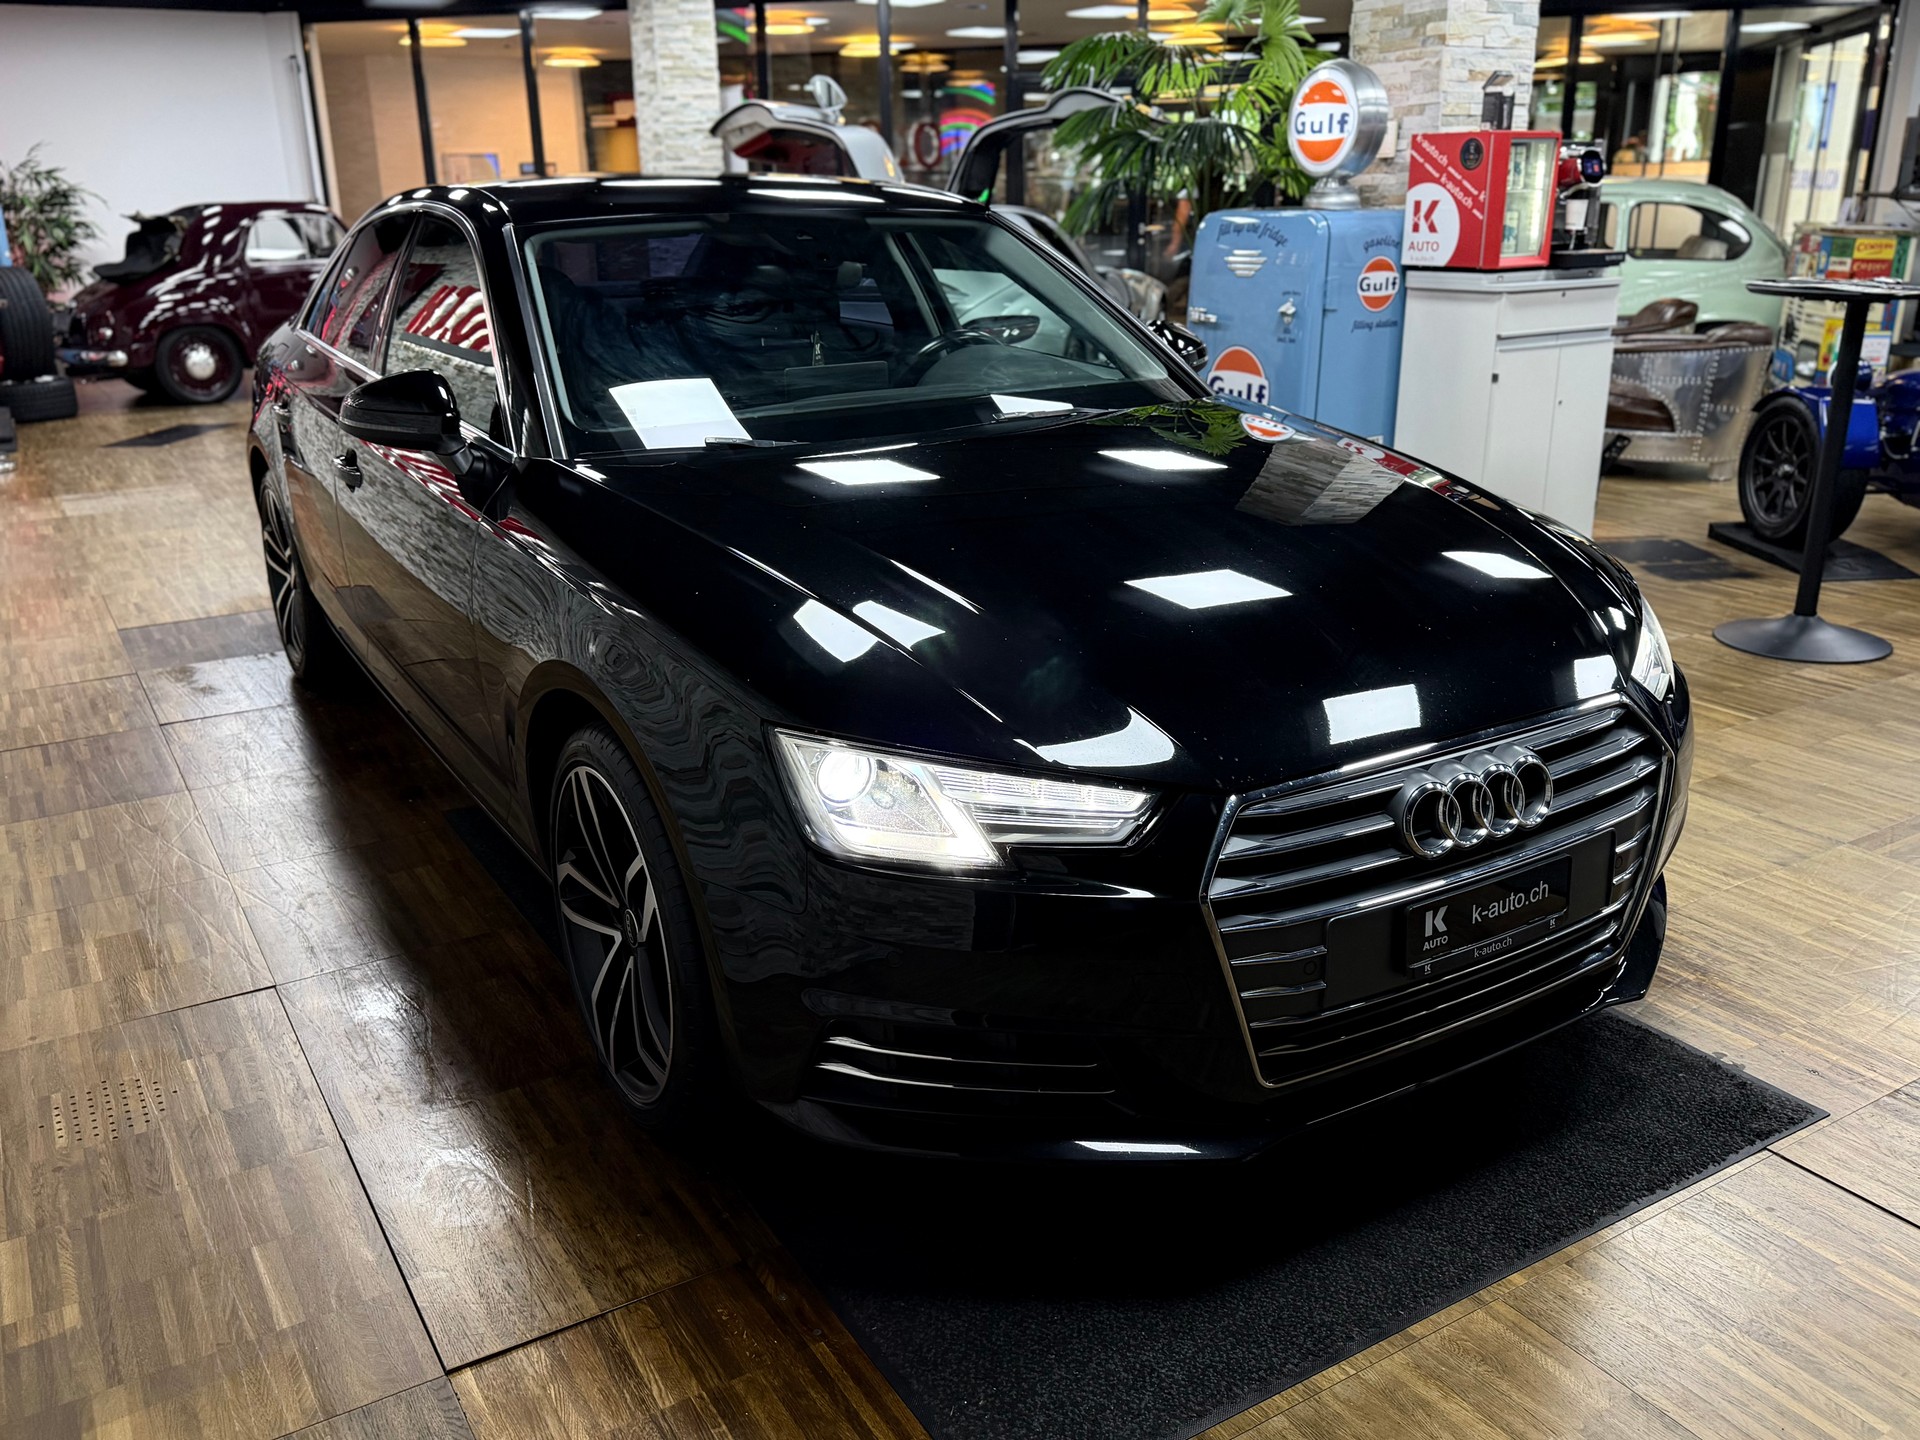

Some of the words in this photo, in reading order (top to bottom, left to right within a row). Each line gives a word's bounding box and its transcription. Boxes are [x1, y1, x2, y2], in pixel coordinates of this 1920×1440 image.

[1295, 111, 1350, 135] Gulf
[1416, 135, 1448, 167] k-auto.ch
[1440, 173, 1473, 209] k-auto.ch
[1412, 200, 1441, 234] K
[1408, 241, 1440, 252] AUTO
[1359, 276, 1399, 293] Gulf
[1472, 880, 1549, 924] k-auto.ch
[1425, 905, 1448, 938] K
[1423, 935, 1449, 951] AUTO
[1474, 936, 1512, 958] k-auto.ch
